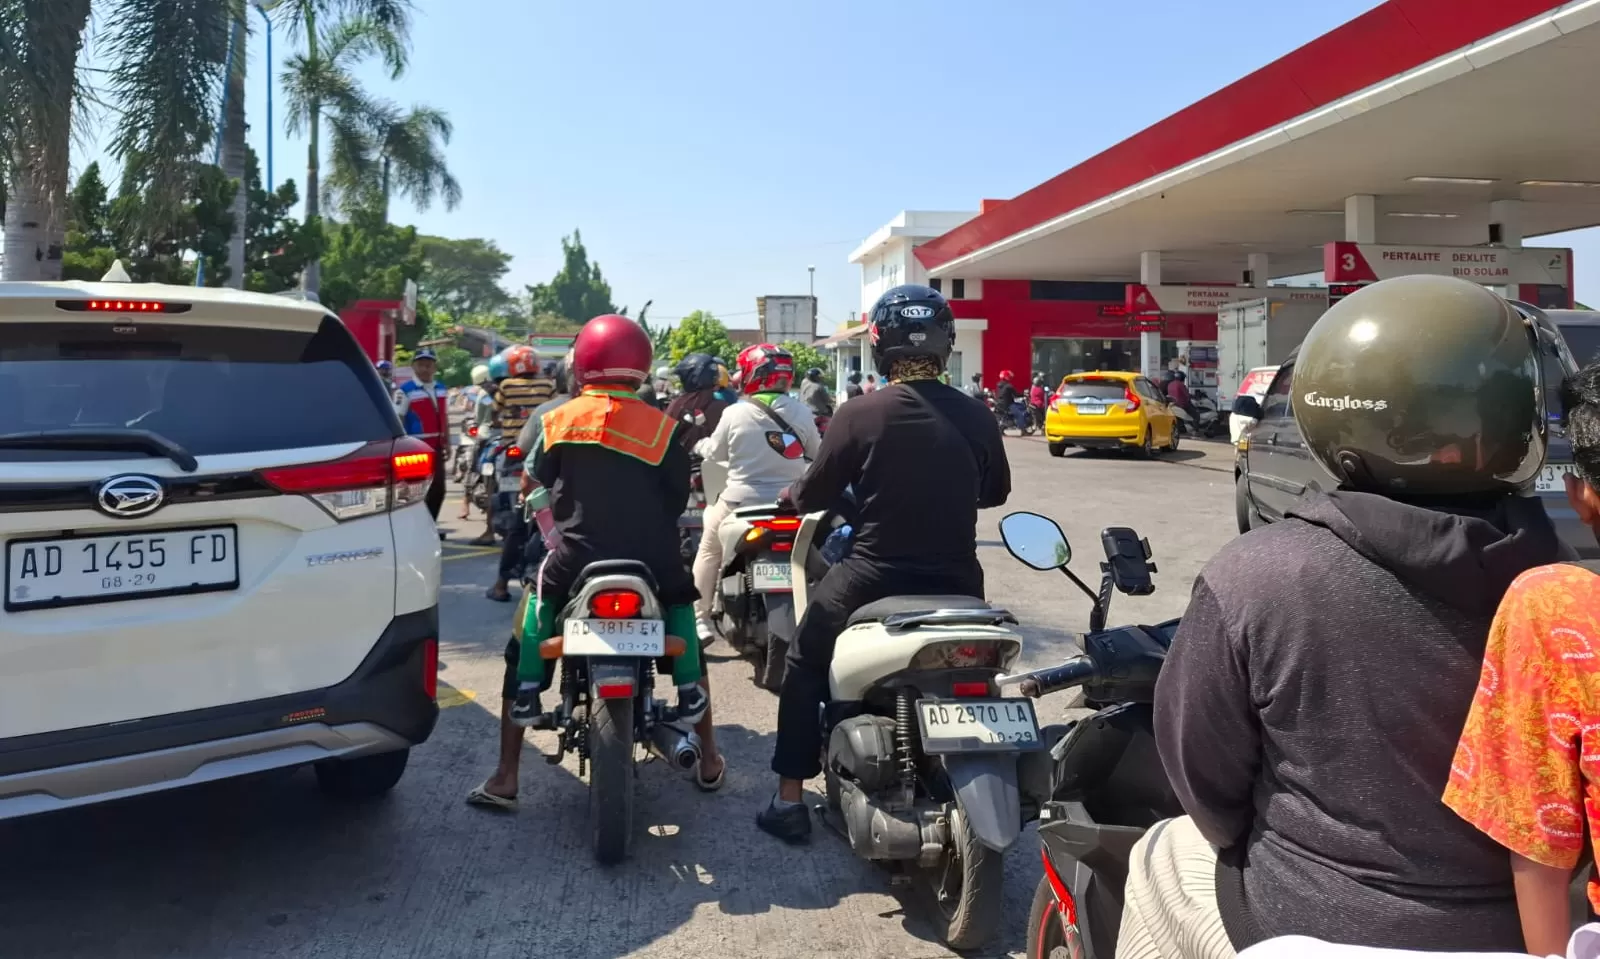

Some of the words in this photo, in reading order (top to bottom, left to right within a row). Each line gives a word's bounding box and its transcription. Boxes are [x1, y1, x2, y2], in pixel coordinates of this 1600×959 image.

[1341, 253, 1356, 271] 3
[1382, 251, 1441, 262] PERTALITE
[1452, 253, 1497, 263] DEXLITE
[1452, 266, 1471, 276] BIO
[1474, 267, 1509, 277] SOLAR
[1136, 292, 1147, 304] 4
[1187, 290, 1230, 298] PERTAMAX
[904, 307, 931, 318] KYT
[1304, 391, 1388, 412] Cargloss
[20, 545, 62, 579] AD
[82, 538, 166, 574] 1455
[190, 534, 227, 564] FD
[571, 620, 590, 636] AD
[598, 621, 635, 635] 3815
[928, 706, 950, 726] AD
[955, 705, 998, 724] 2970
[1004, 704, 1028, 723] LA
